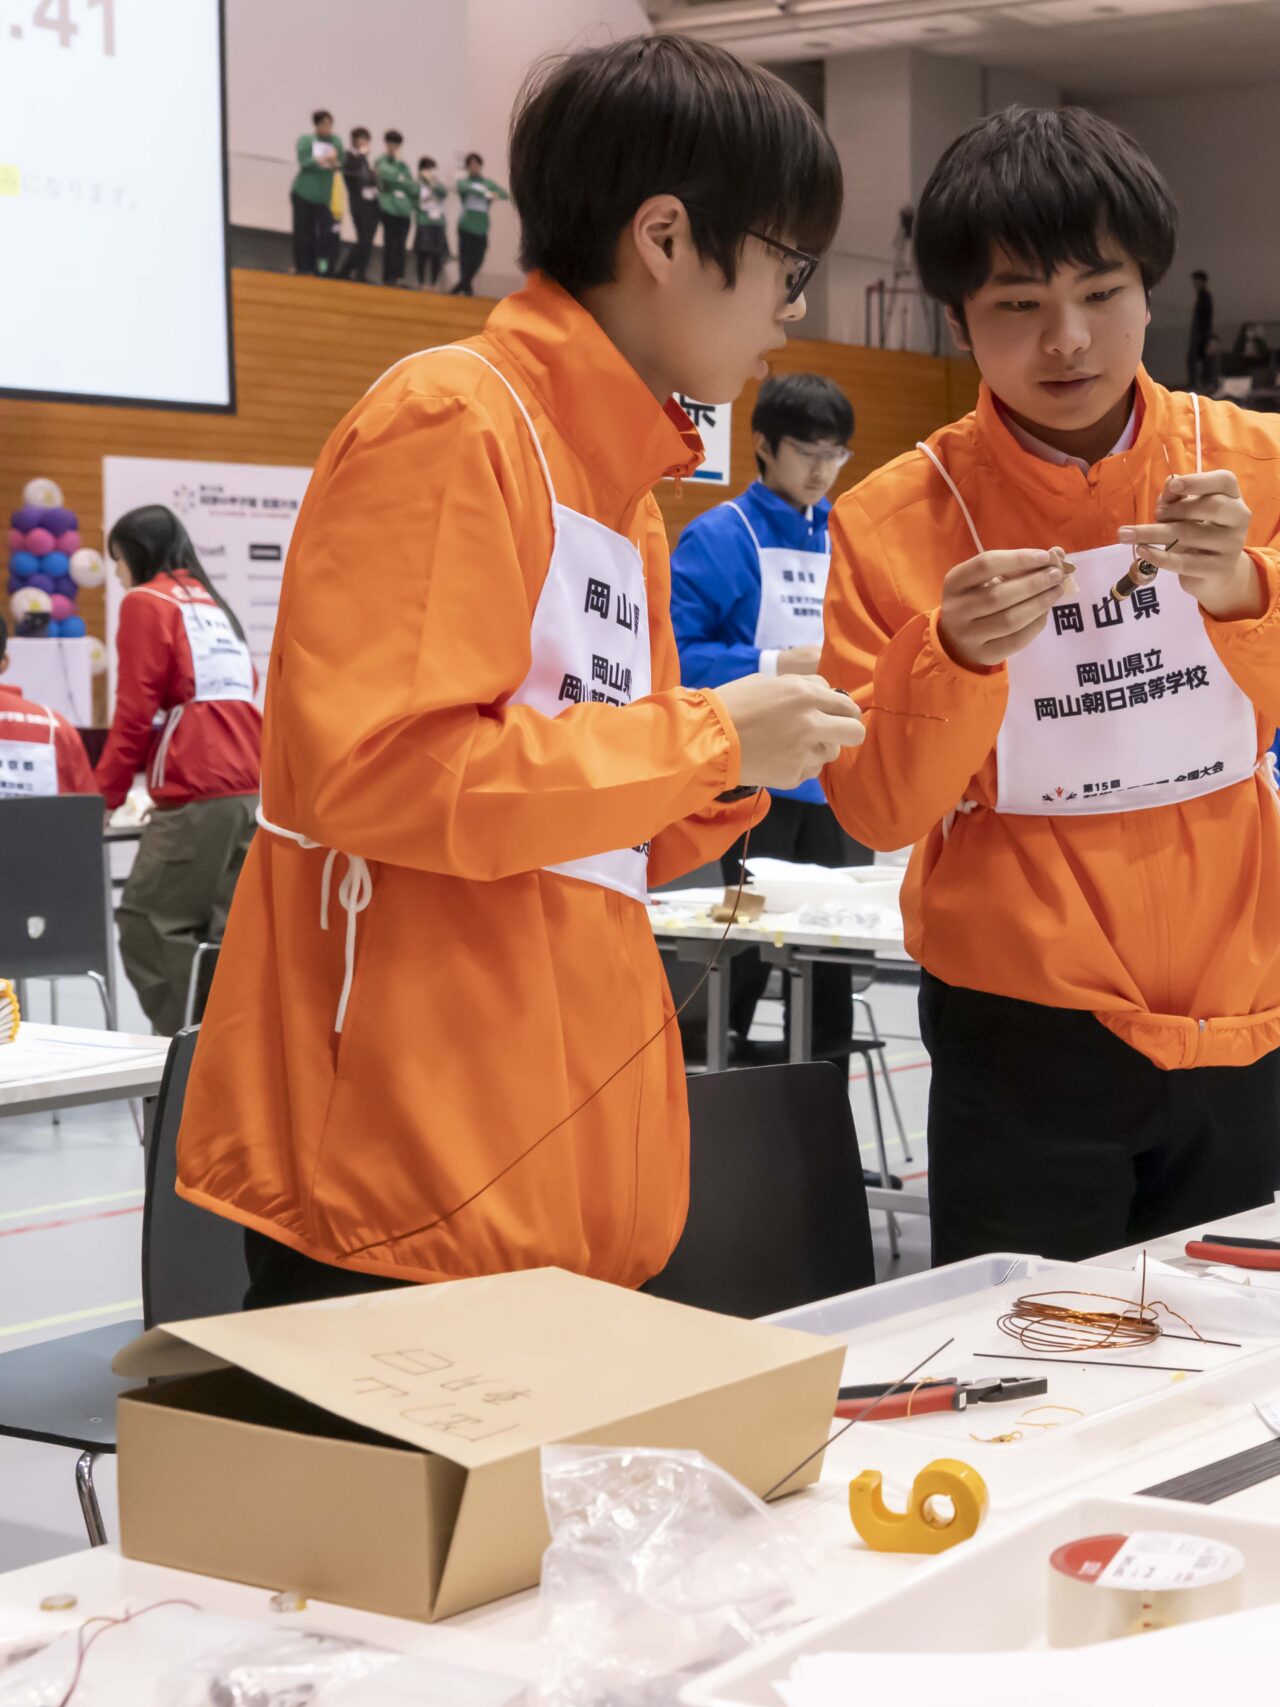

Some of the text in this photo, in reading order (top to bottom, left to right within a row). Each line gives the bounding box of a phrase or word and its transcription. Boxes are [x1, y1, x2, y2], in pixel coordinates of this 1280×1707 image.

[1051, 586, 1161, 635] 岡山県
[1076, 648, 1164, 687] 岡山県立
[1034, 665, 1210, 721] 岡山朝日高等学校
